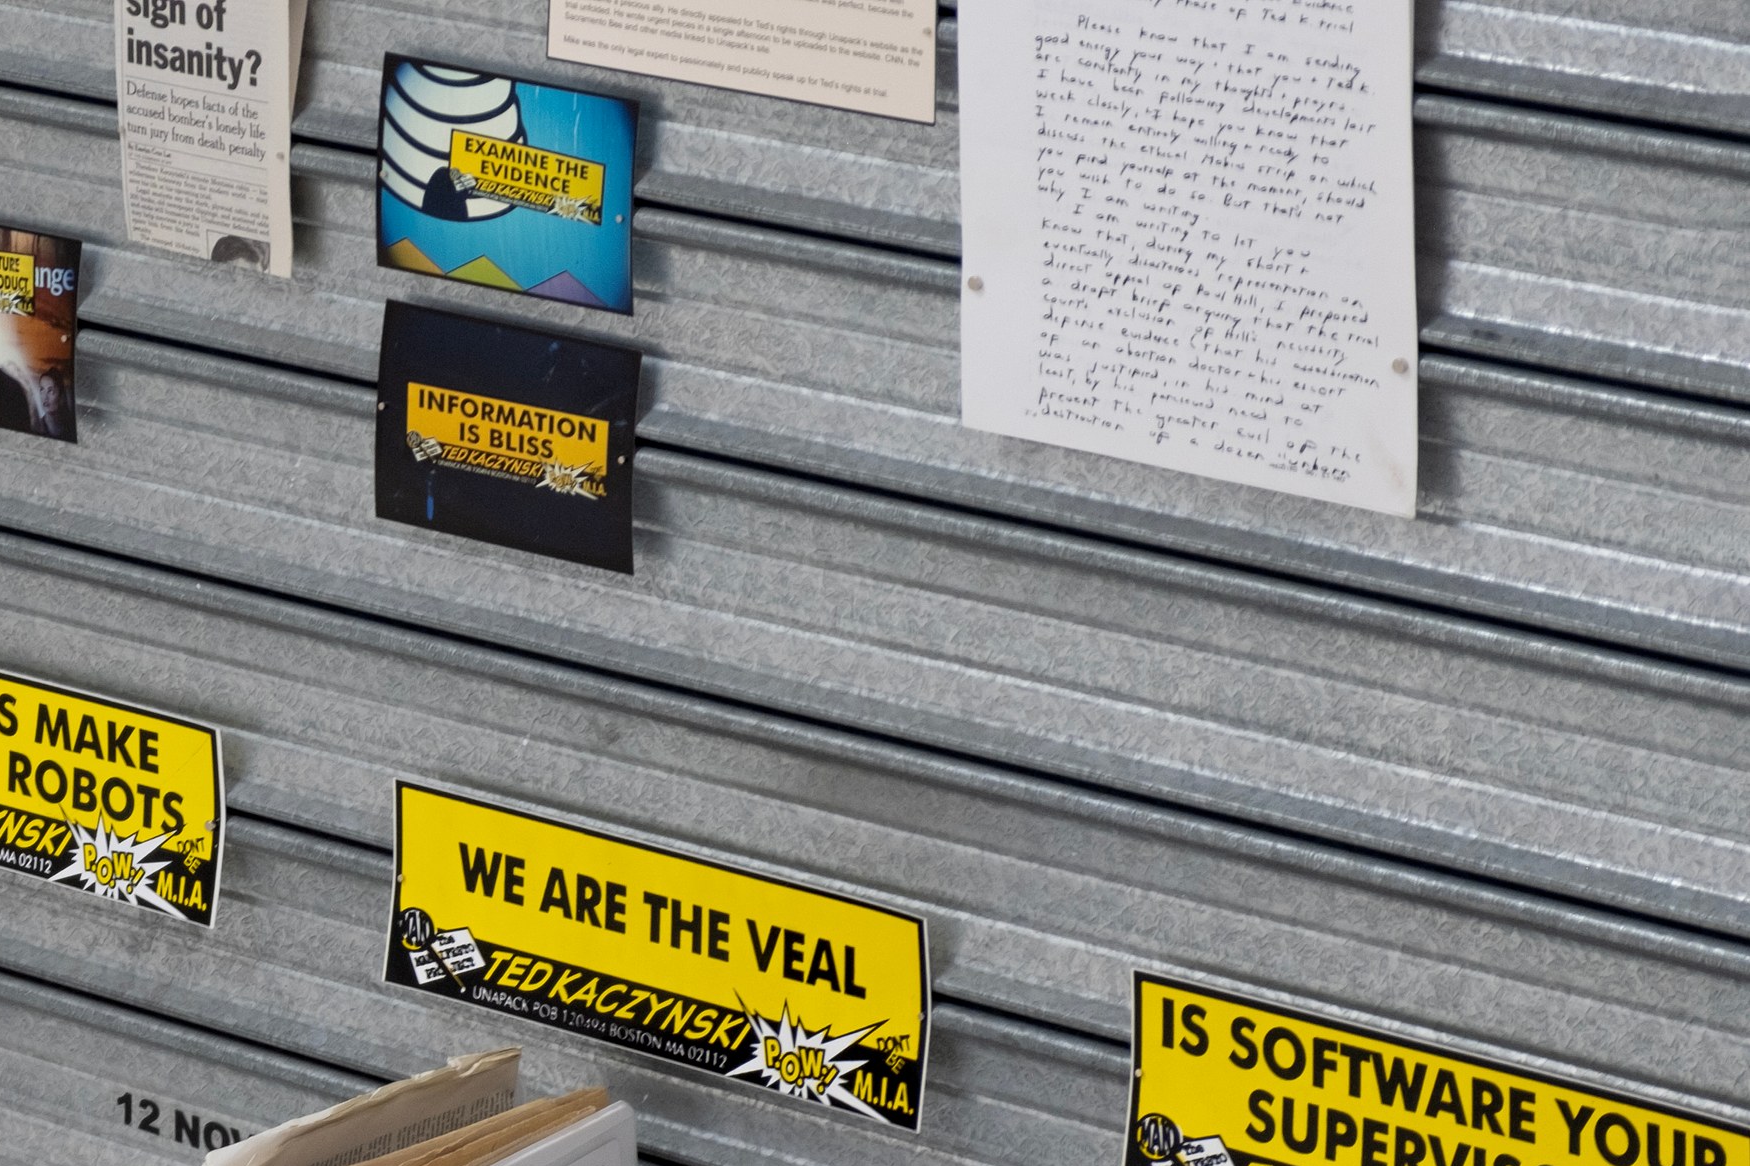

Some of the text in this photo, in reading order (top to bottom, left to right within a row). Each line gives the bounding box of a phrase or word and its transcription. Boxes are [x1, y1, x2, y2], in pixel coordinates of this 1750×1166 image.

[196, 0, 226, 32] of
[126, 27, 262, 90] insanity?
[126, 81, 258, 119] Defense hopes facts of the
[126, 105, 266, 140] accused bomber's lonely life
[126, 122, 266, 162] turn jury from death penalty
[464, 137, 589, 180] EXAMINE THE
[480, 162, 570, 194] EVIDENCE
[475, 179, 555, 205] TED KACZYNSKI
[418, 389, 597, 443] INFORMATION
[441, 444, 544, 478] TED KACZYNSKI
[459, 422, 554, 459] IS BLISS
[34, 702, 159, 775] MAKE
[7, 752, 183, 836] ROBOTS
[0, 847, 16, 863] MA
[19, 853, 52, 873] 02112
[156, 870, 207, 911] M.I.A.
[458, 842, 867, 999] WE ARE THE VEAL
[482, 950, 750, 1051] TED KACZYNSKI
[473, 985, 728, 1069] UNAPACK POB BOSTON MA 02112
[854, 1069, 914, 1115] M.I.A.
[1161, 997, 1209, 1058] IS
[1229, 1016, 1536, 1144] SOFTWARE
[116, 1092, 160, 1136] 12
